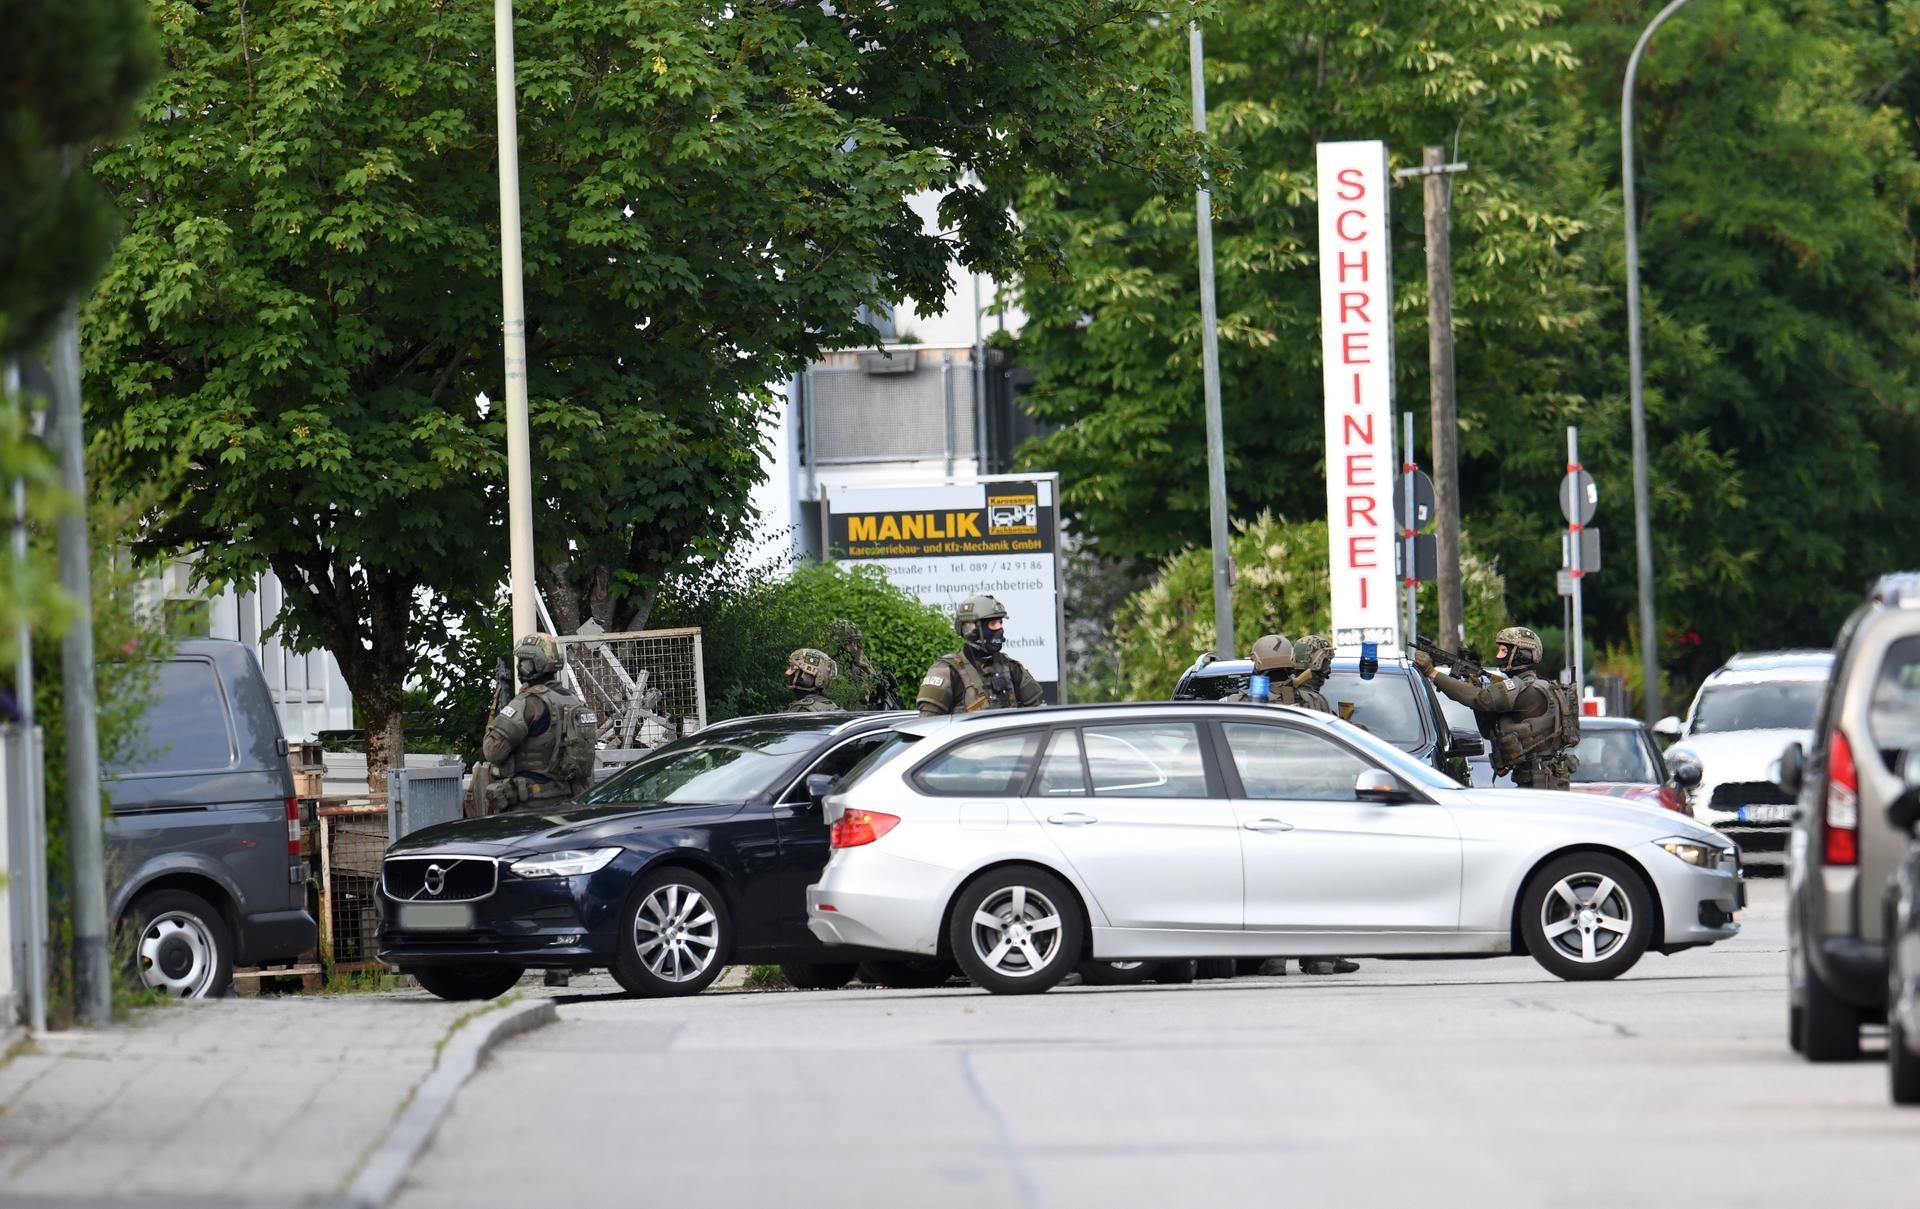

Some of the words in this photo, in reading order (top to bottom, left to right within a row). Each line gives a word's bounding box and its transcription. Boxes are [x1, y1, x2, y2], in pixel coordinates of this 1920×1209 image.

[1336, 169, 1377, 609] SCHREINEREI
[848, 512, 982, 541] MANLIK
[923, 542, 942, 553] und
[945, 540, 1009, 552] Kfz-Mechanik
[1012, 539, 1042, 550] GmbH
[928, 564, 938, 574] 11
[969, 562, 988, 572] 089
[1000, 562, 1012, 571] 42
[1015, 562, 1026, 571] 91
[1030, 561, 1042, 570] 86
[935, 579, 1043, 594] Innungsfachbetrieb
